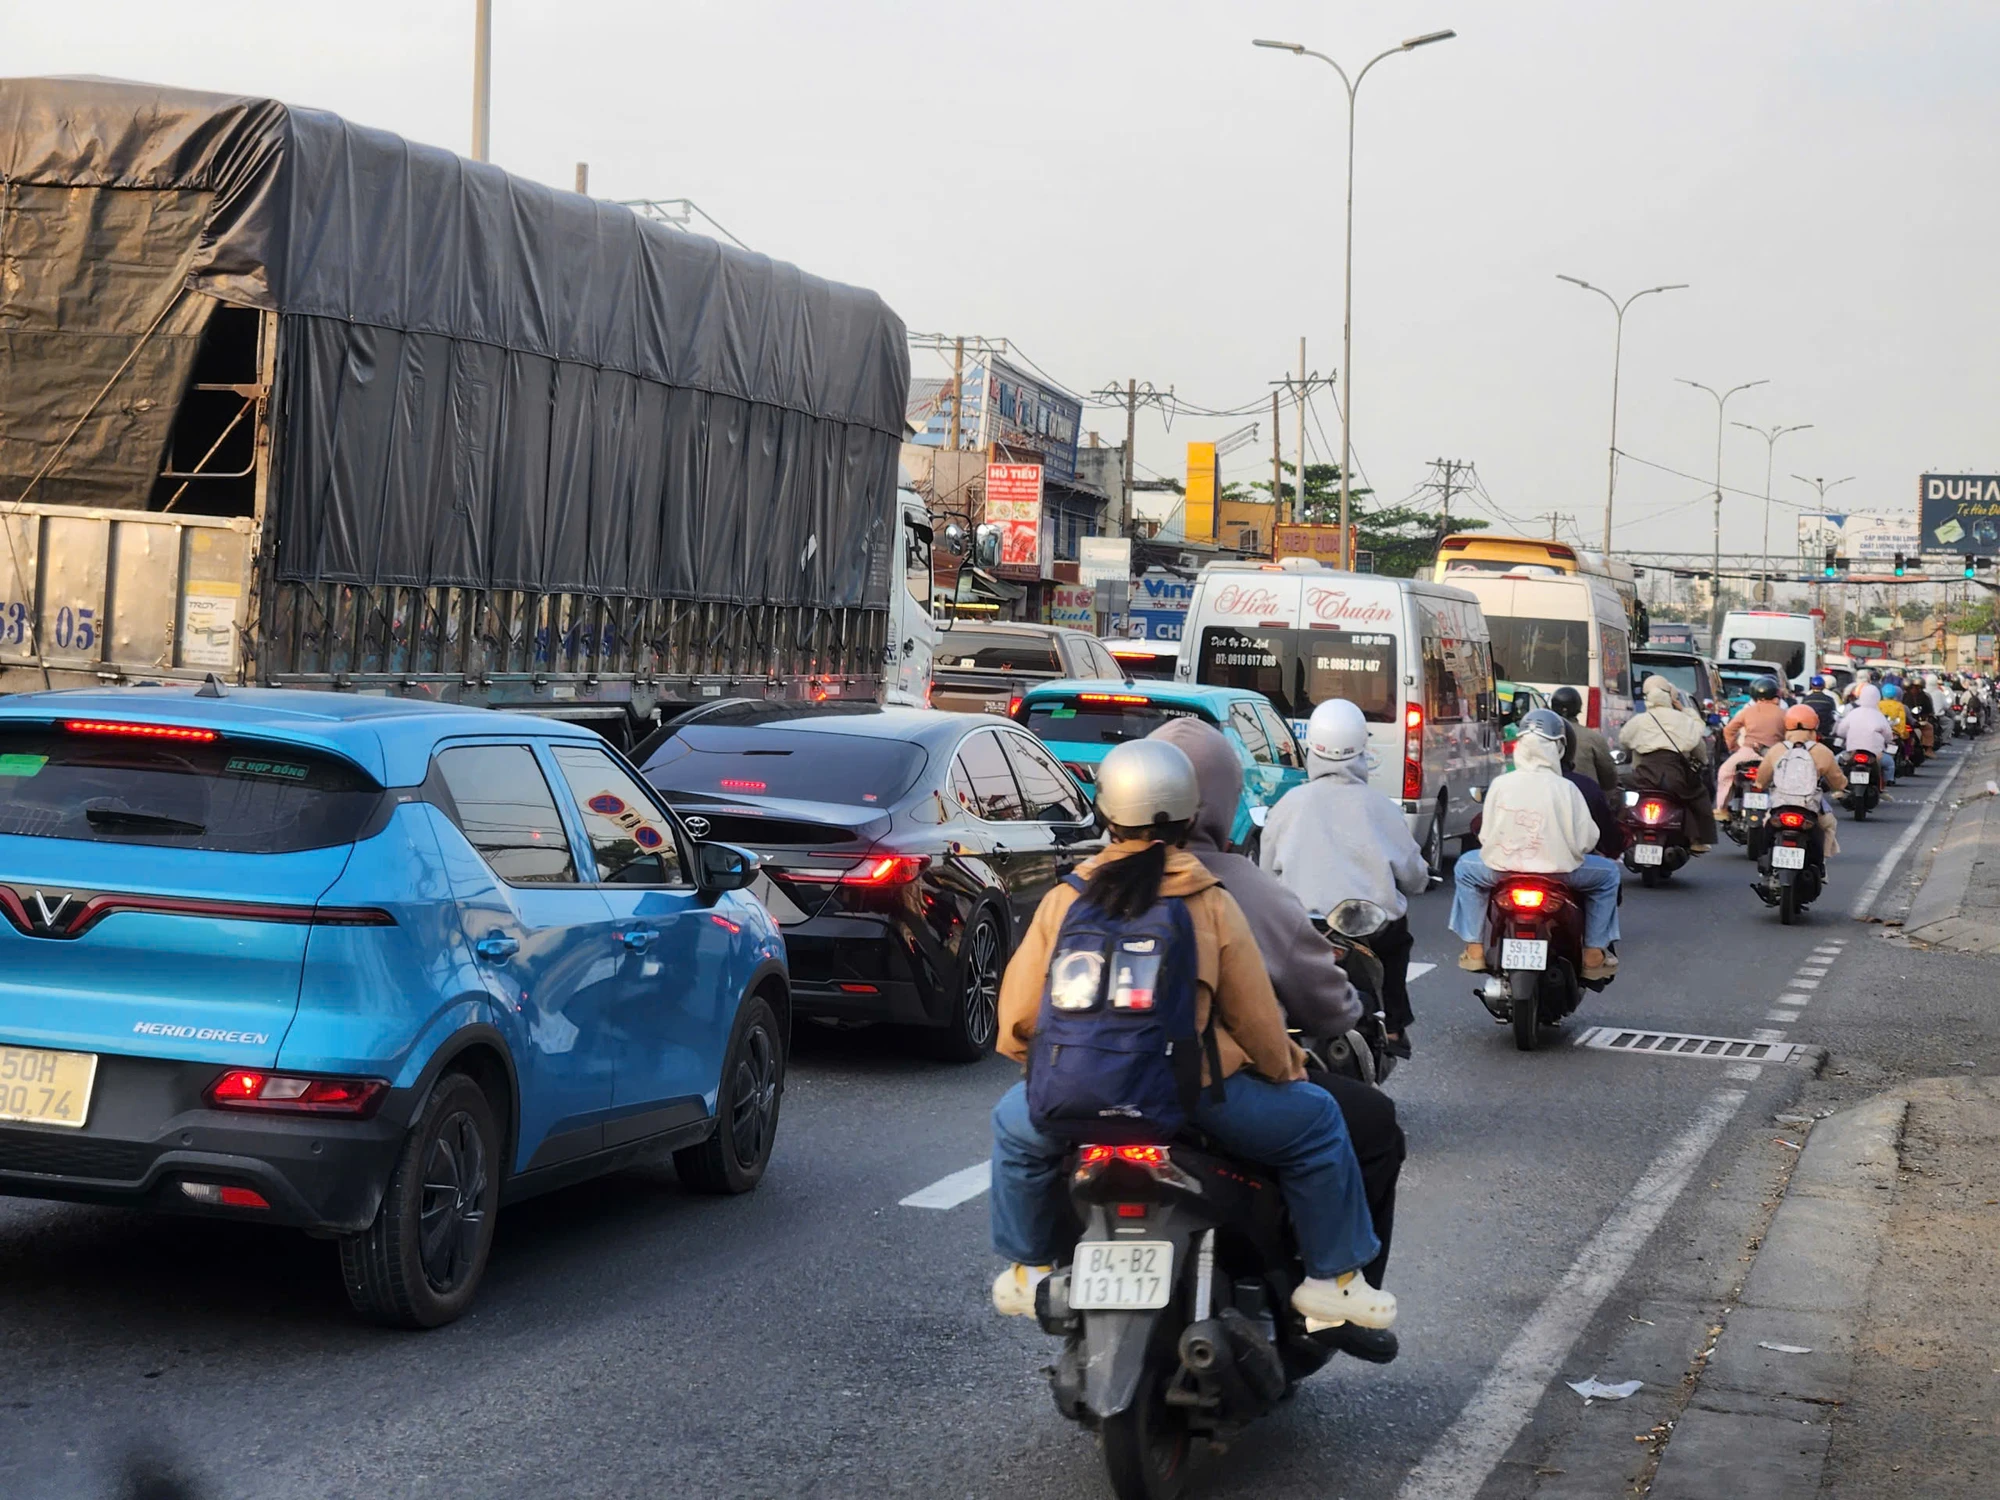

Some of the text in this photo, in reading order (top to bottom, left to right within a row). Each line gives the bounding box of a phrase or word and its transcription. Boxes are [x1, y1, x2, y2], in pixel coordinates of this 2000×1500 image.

[56, 606, 94, 650] 05
[229, 760, 245, 769] XE
[133, 1021, 270, 1045] HERIO GREEN
